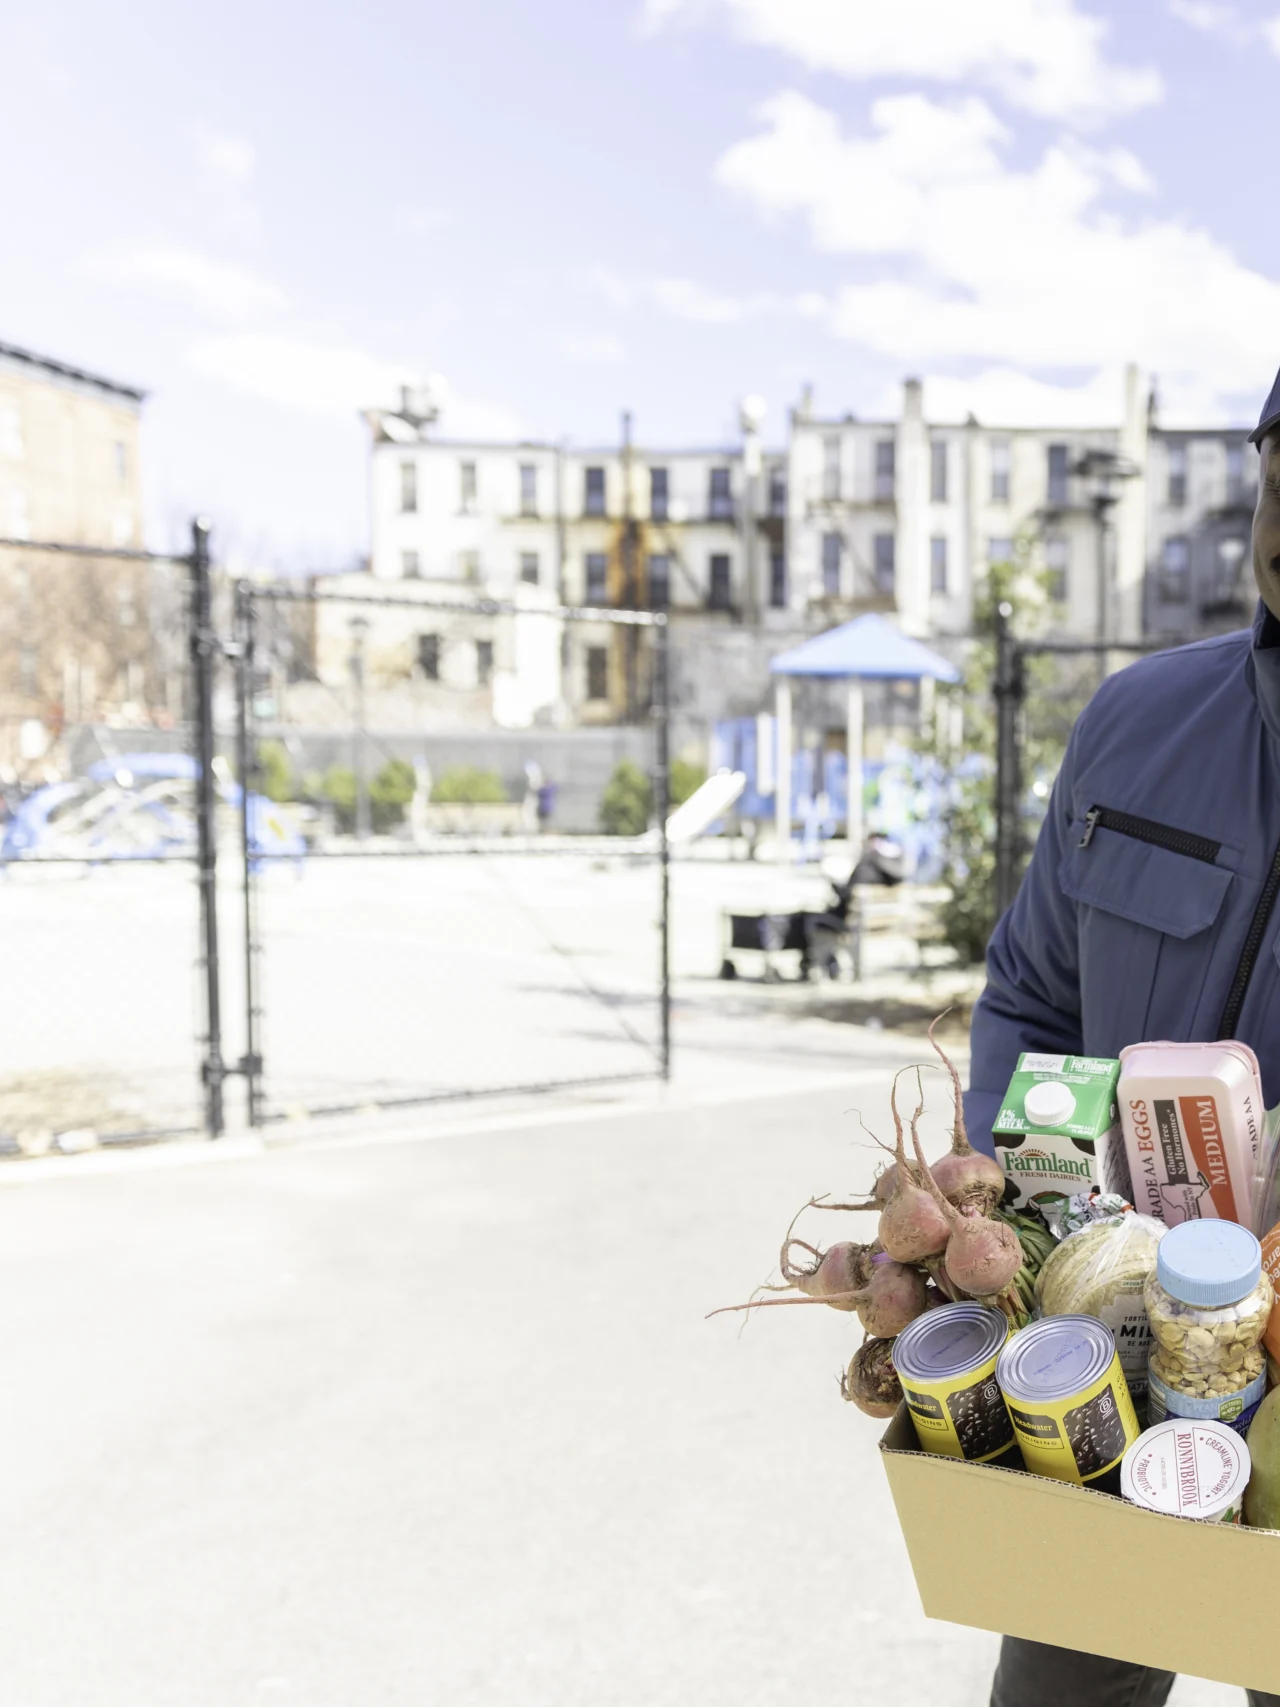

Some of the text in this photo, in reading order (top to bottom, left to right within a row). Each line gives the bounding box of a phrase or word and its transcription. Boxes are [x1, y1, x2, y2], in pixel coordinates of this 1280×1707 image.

[1161, 1123, 1177, 1175] Gluten Free
[1196, 1100, 1228, 1185] MEDIUM
[1246, 1115, 1258, 1159] RADE
[1004, 1151, 1091, 1178] Farmland
[1049, 1173, 1081, 1181] DAIRIES
[1130, 1100, 1166, 1222] RADE AA EGGS
[1177, 1161, 1187, 1175] No
[1177, 1433, 1197, 1507] RONNYBROOK
[1205, 1437, 1233, 1468] CREAMLINE
[1137, 1458, 1152, 1493] PROBIOTIC
[1211, 1471, 1232, 1495] YOGURT
